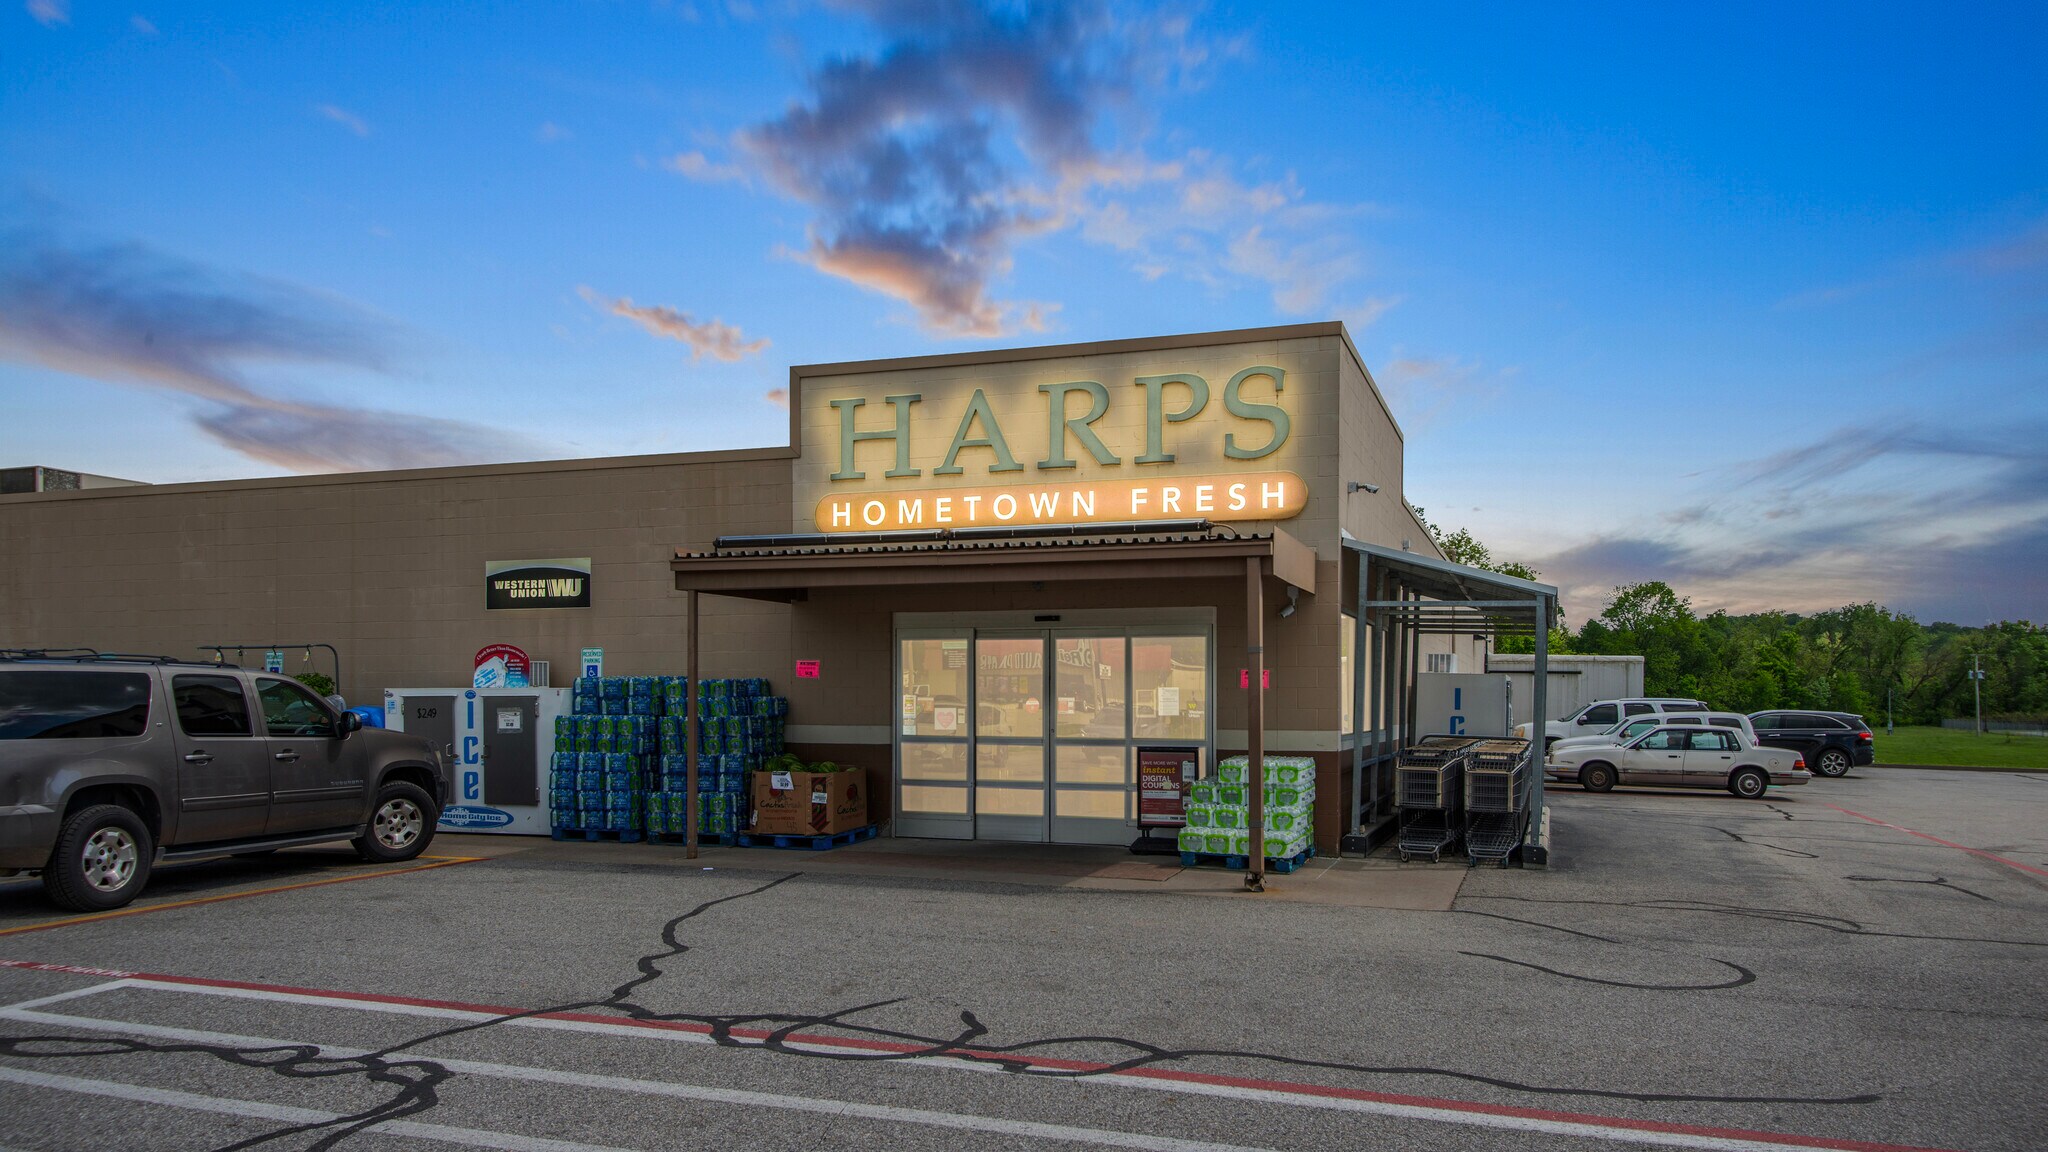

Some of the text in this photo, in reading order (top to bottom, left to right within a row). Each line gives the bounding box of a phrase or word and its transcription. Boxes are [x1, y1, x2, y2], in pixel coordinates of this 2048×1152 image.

[830, 365, 1291, 482] HARPS
[832, 481, 1285, 527] HOMETOWN FRESH
[494, 579, 546, 590] WESTERN
[510, 588, 546, 598] UNION
[1142, 766, 1176, 774] instant
[1142, 775, 1171, 783] DIGITAL
[1142, 782, 1180, 790] COUPNS
